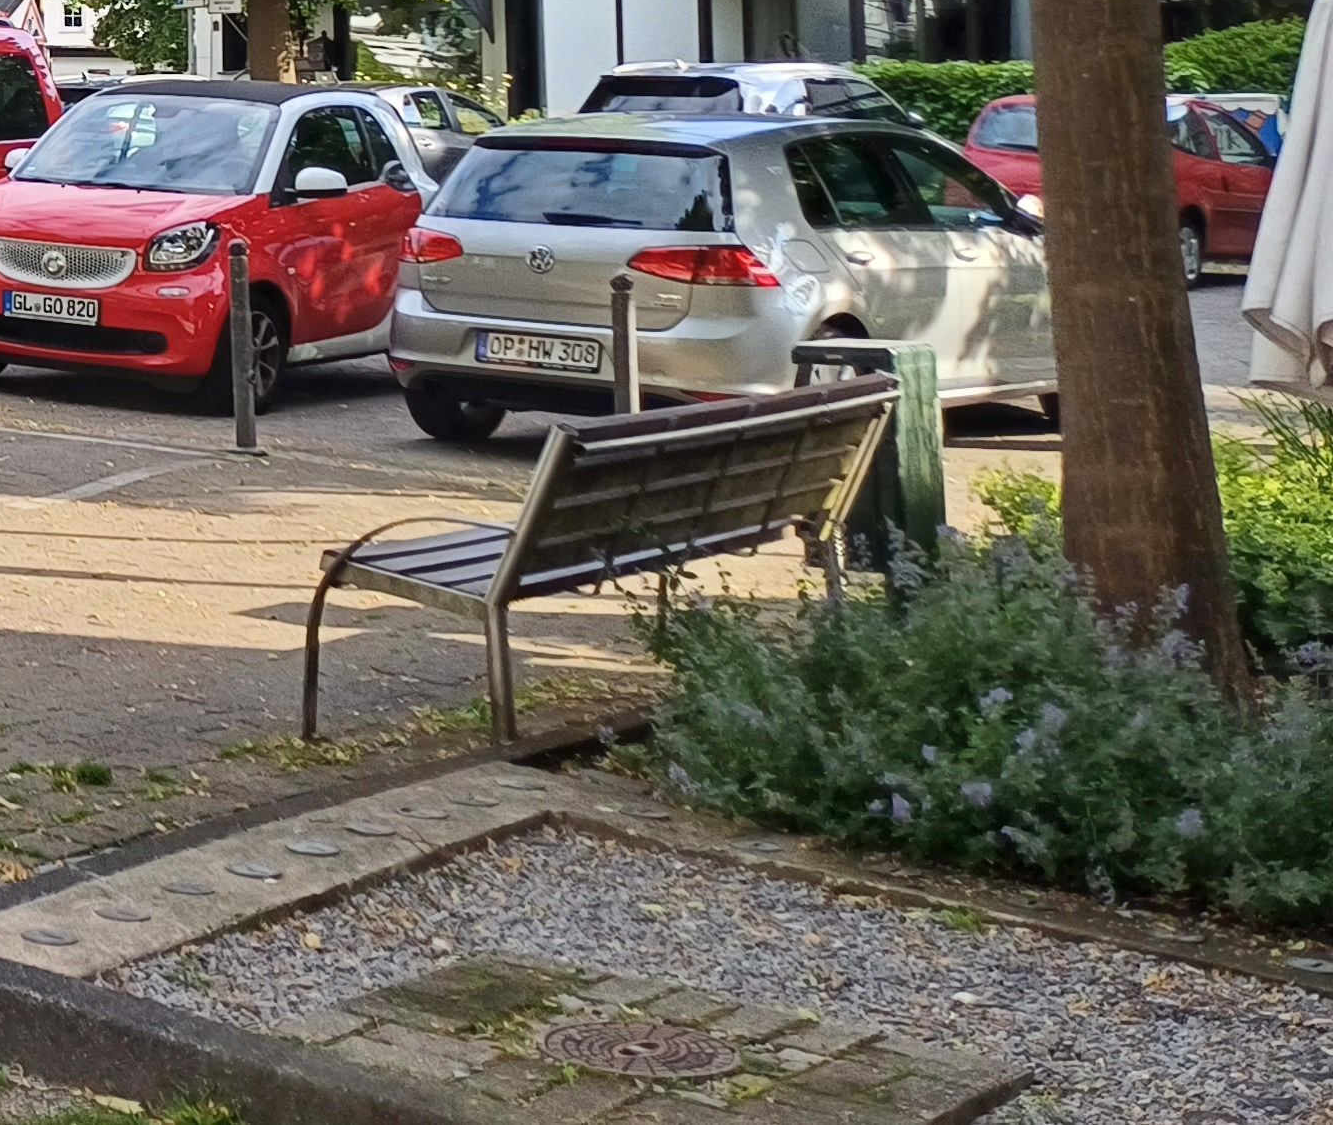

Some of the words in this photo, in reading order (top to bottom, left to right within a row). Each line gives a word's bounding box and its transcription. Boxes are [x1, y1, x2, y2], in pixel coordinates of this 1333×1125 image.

[13, 293, 33, 312] GL
[43, 296, 63, 315] GO
[66, 298, 96, 318] 820
[490, 336, 515, 356] OP
[527, 339, 554, 360] HW
[558, 341, 596, 364] 308
